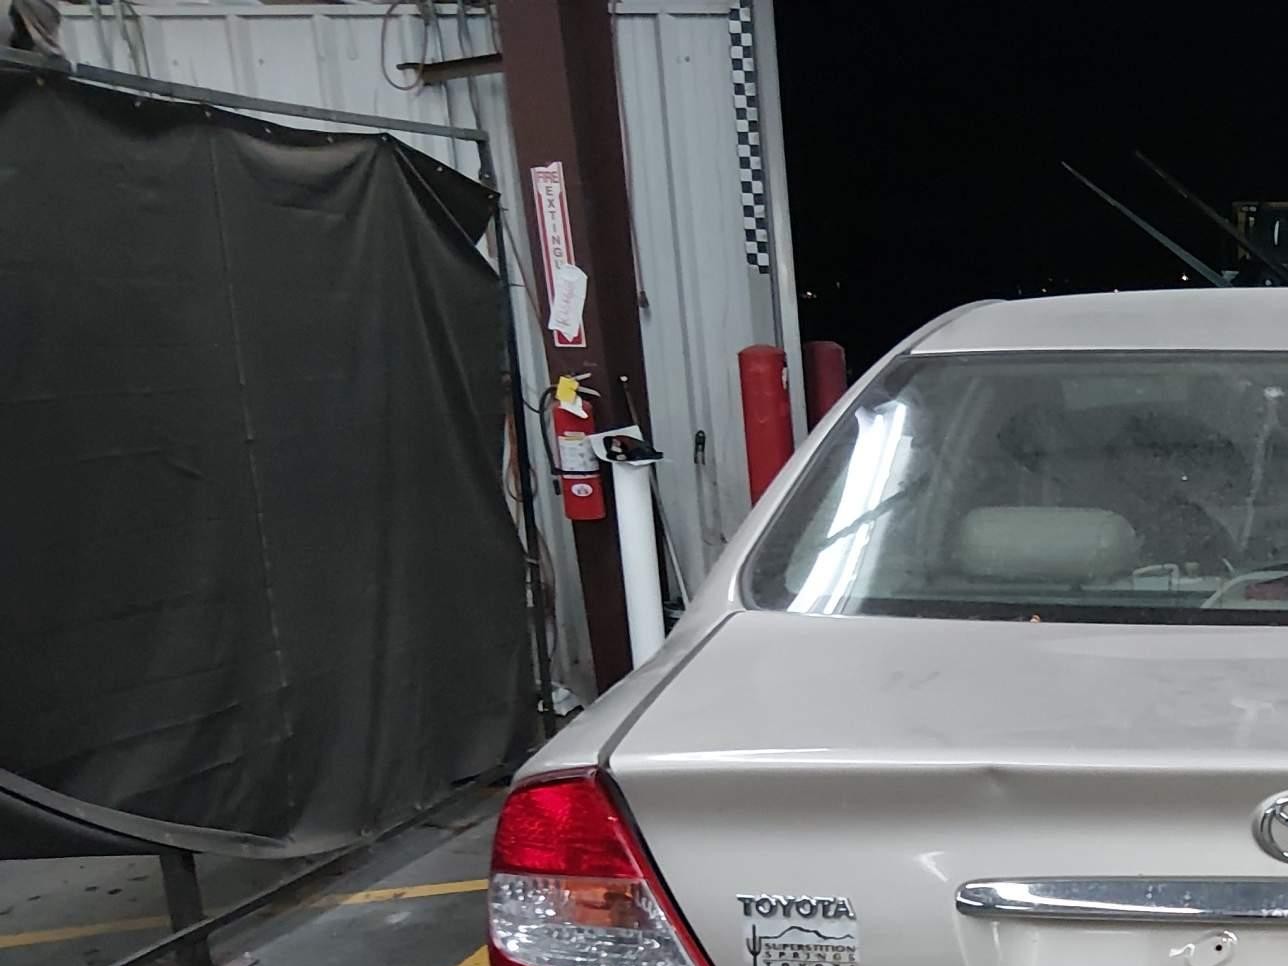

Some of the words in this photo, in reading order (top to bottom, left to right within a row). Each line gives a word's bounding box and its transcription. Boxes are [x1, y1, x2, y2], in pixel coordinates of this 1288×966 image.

[535, 170, 560, 184] FIRE
[736, 893, 857, 921] TOYOTA
[764, 943, 857, 954] SUPERSTITION
[764, 951, 857, 962] SPRINGS
